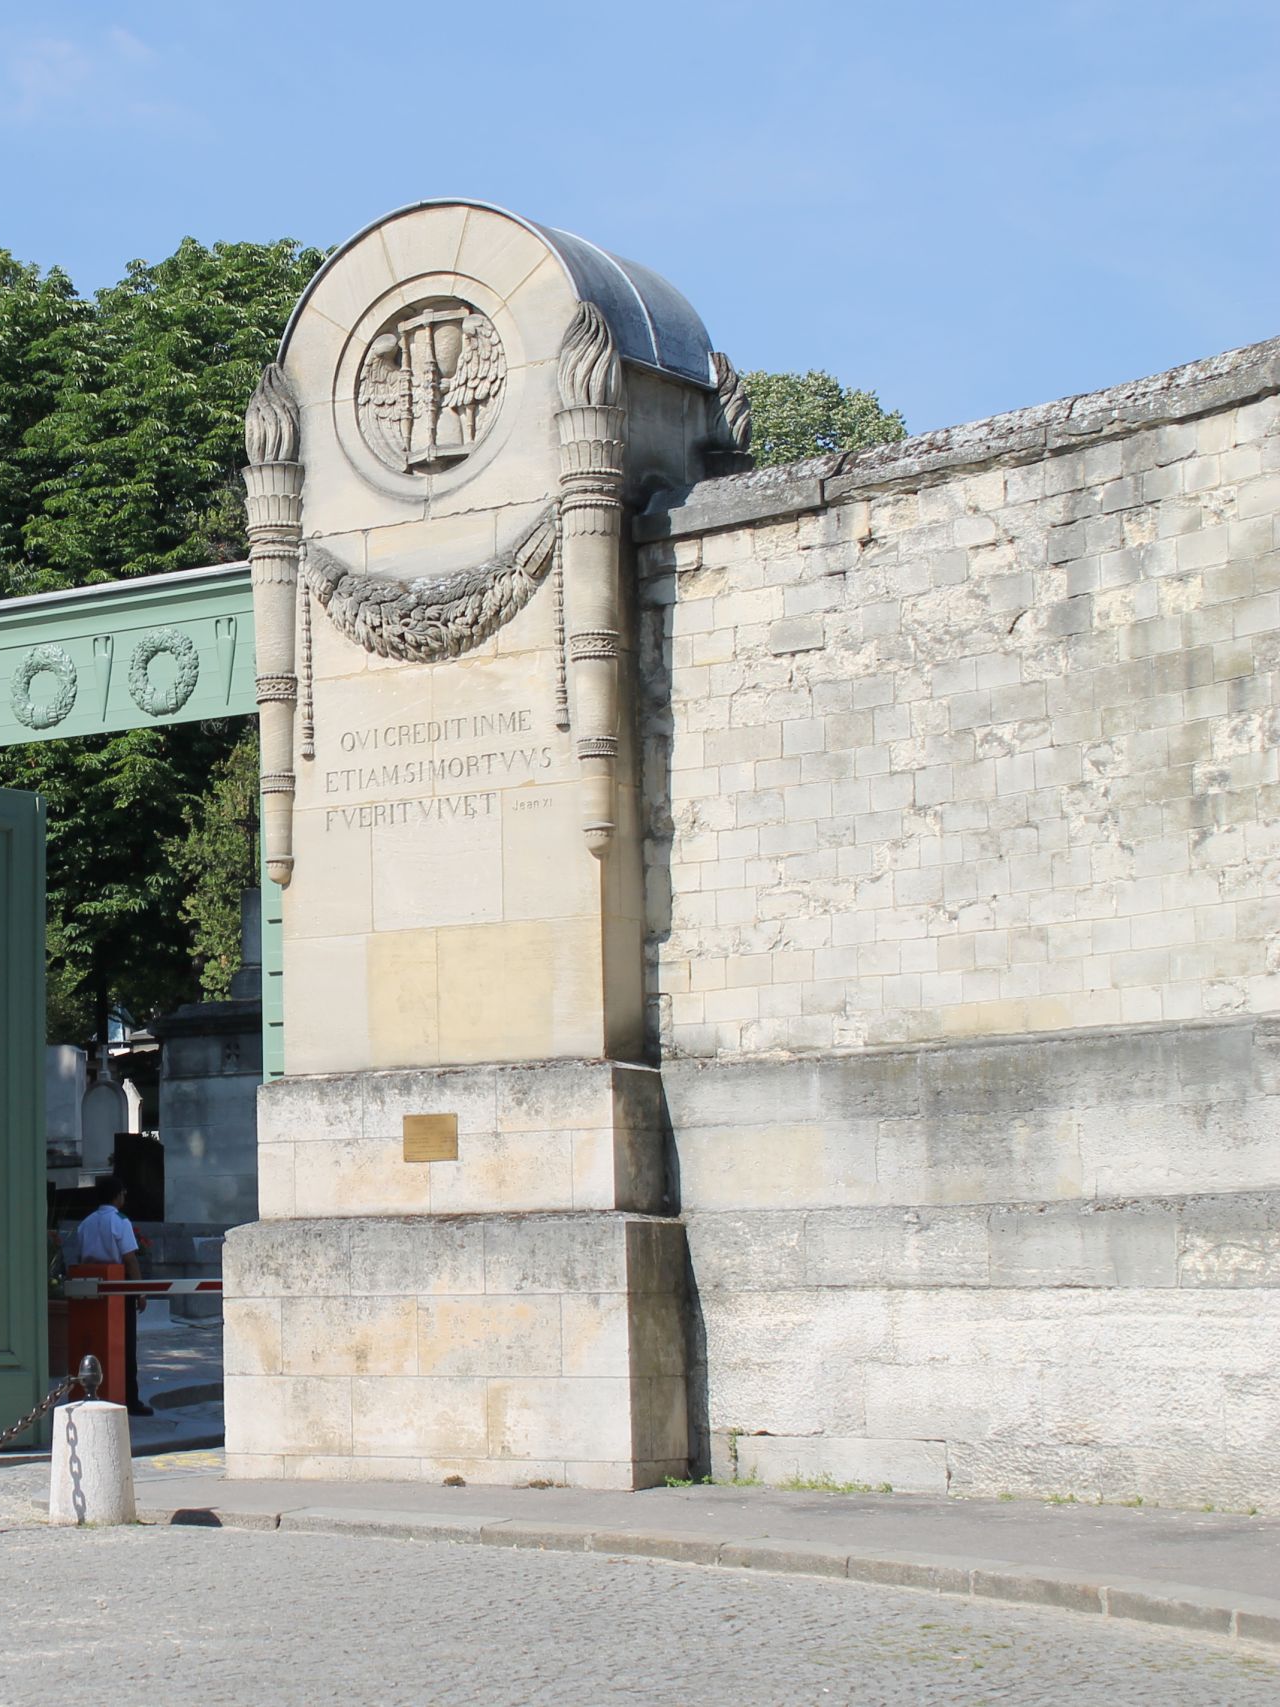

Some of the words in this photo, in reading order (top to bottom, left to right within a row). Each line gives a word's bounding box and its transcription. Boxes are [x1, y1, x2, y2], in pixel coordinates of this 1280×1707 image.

[383, 717, 467, 747] CREDIT
[473, 713, 495, 737] IN
[498, 709, 532, 733] ME
[428, 747, 552, 780] MORTVVS
[326, 802, 413, 832] FVERIT
[418, 792, 496, 819] VIVET
[512, 799, 540, 811] Jean
